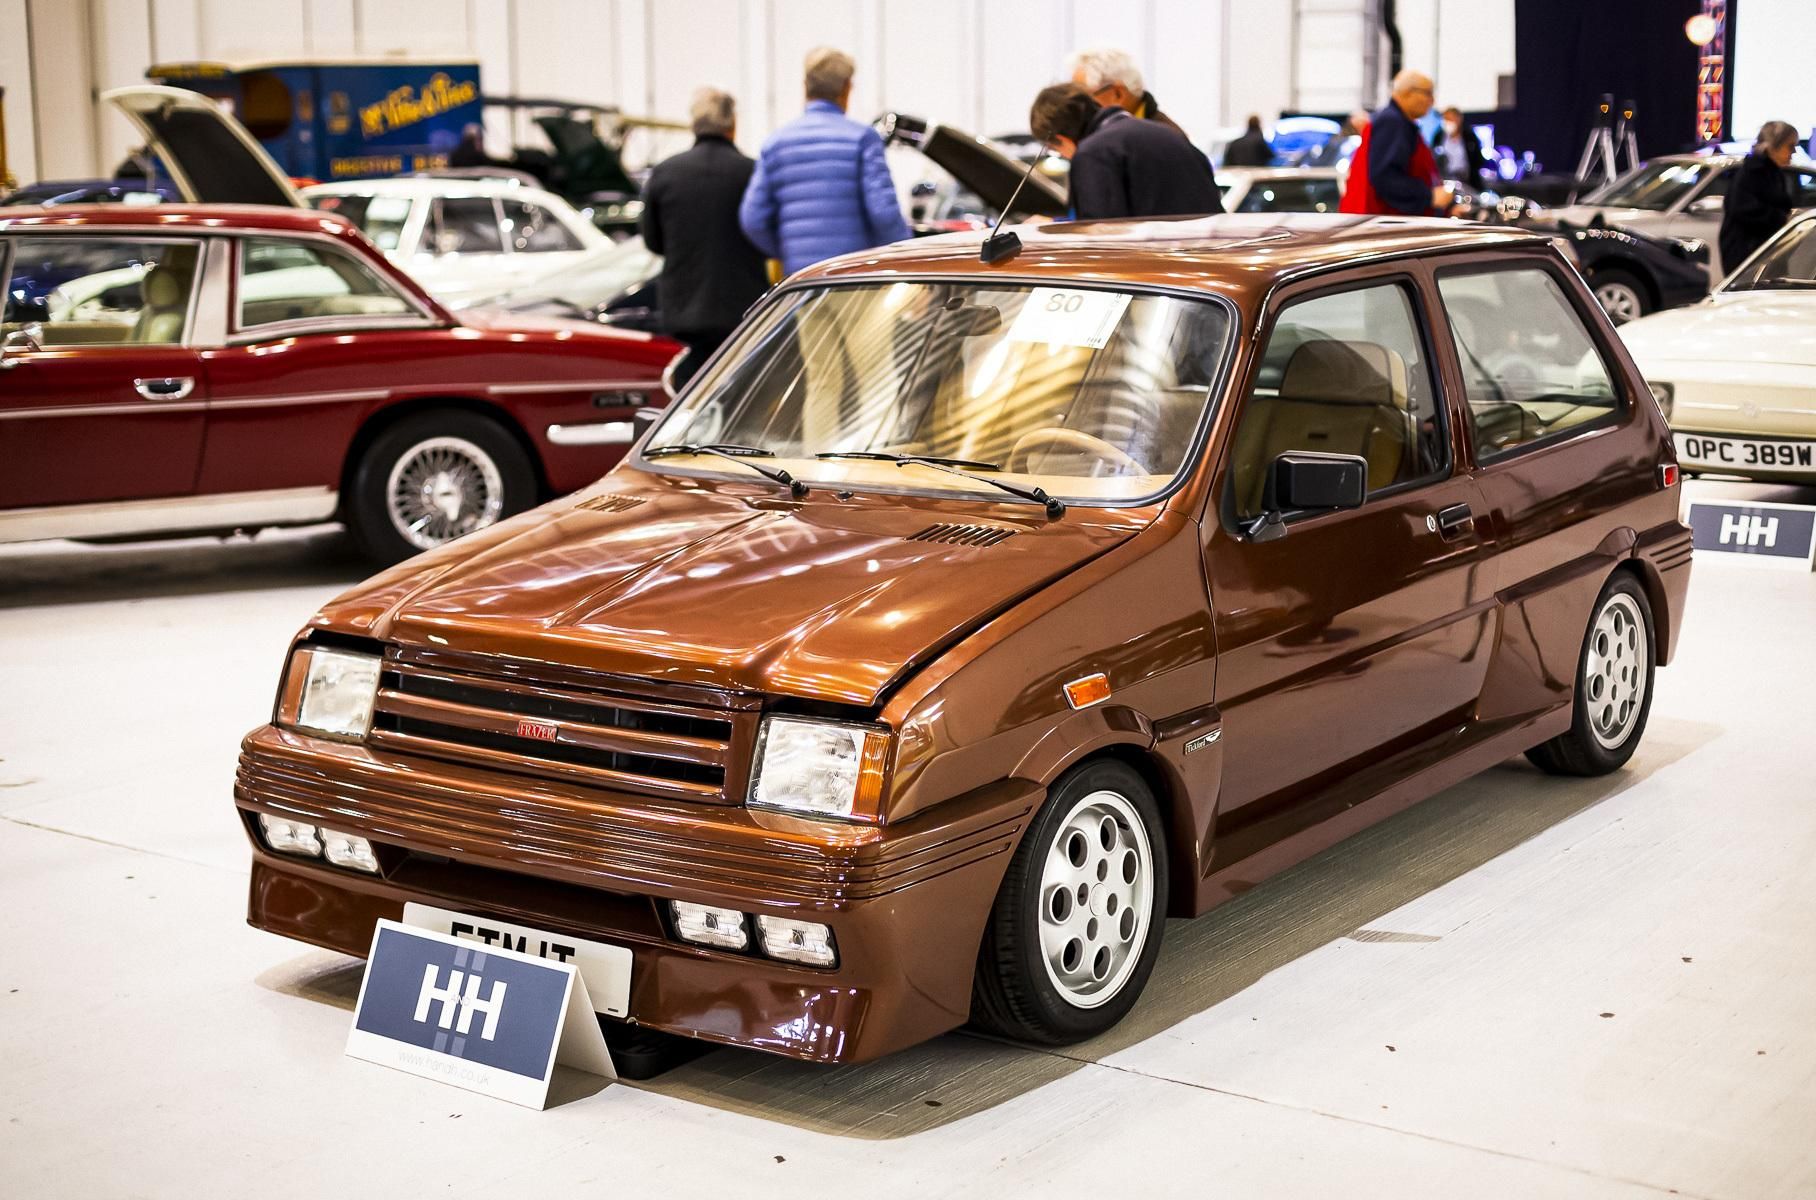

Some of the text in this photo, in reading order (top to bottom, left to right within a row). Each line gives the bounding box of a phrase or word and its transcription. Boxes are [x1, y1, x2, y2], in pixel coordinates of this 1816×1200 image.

[1685, 438, 1812, 466] OPC 389W
[1719, 513, 1779, 548] HH
[520, 723, 557, 740] FRAZER
[1187, 738, 1207, 753] Tickford
